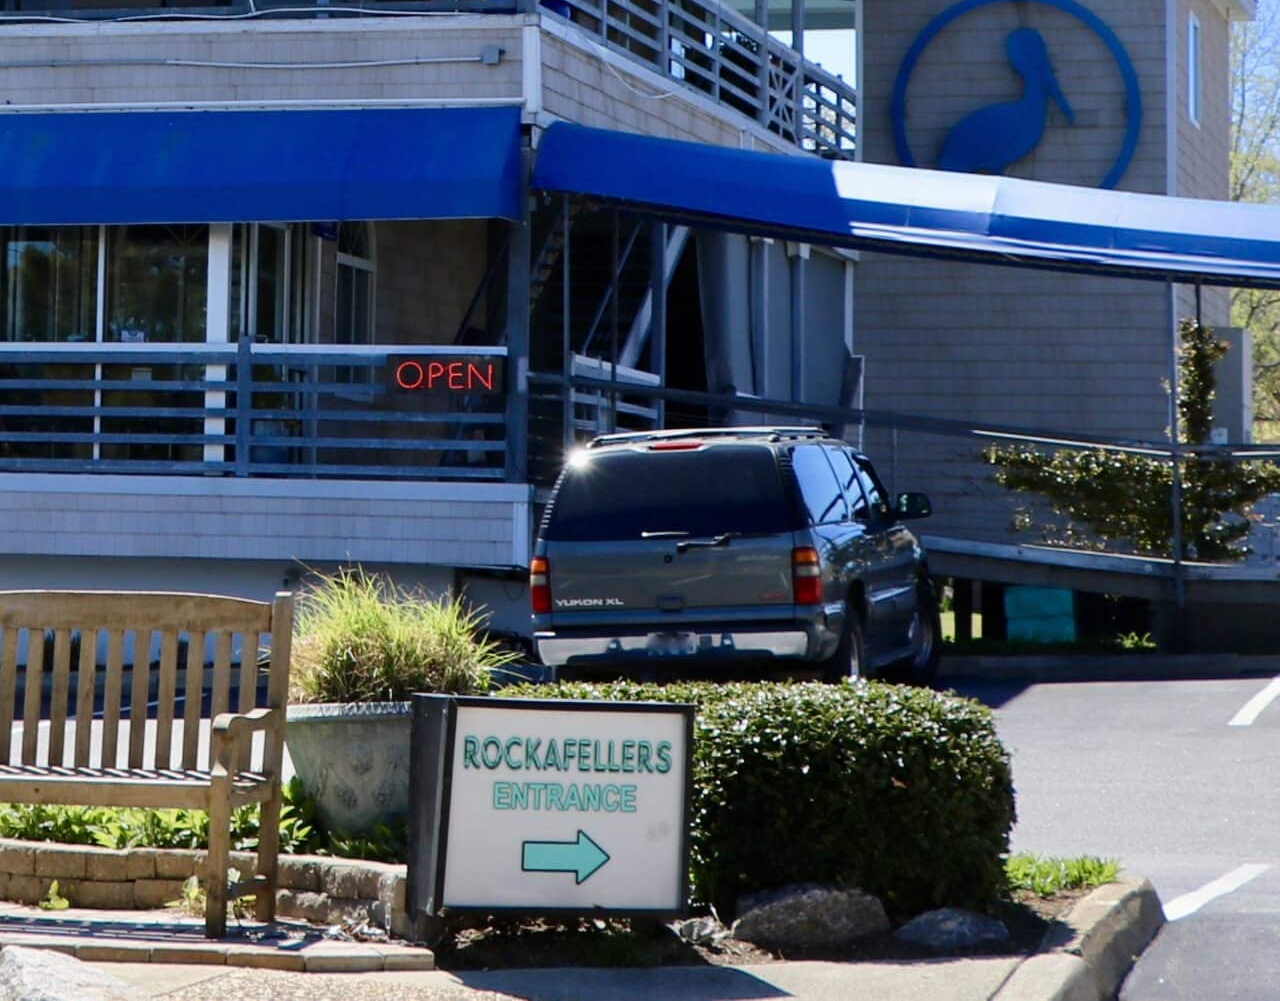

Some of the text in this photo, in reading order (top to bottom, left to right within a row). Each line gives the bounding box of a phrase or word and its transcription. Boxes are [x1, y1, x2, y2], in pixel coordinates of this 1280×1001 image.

[395, 360, 494, 390] OPEN
[555, 598, 625, 607] YUKON XL
[463, 735, 673, 774] ROCKAFELLERS
[492, 781, 637, 813] ENTRANCE
